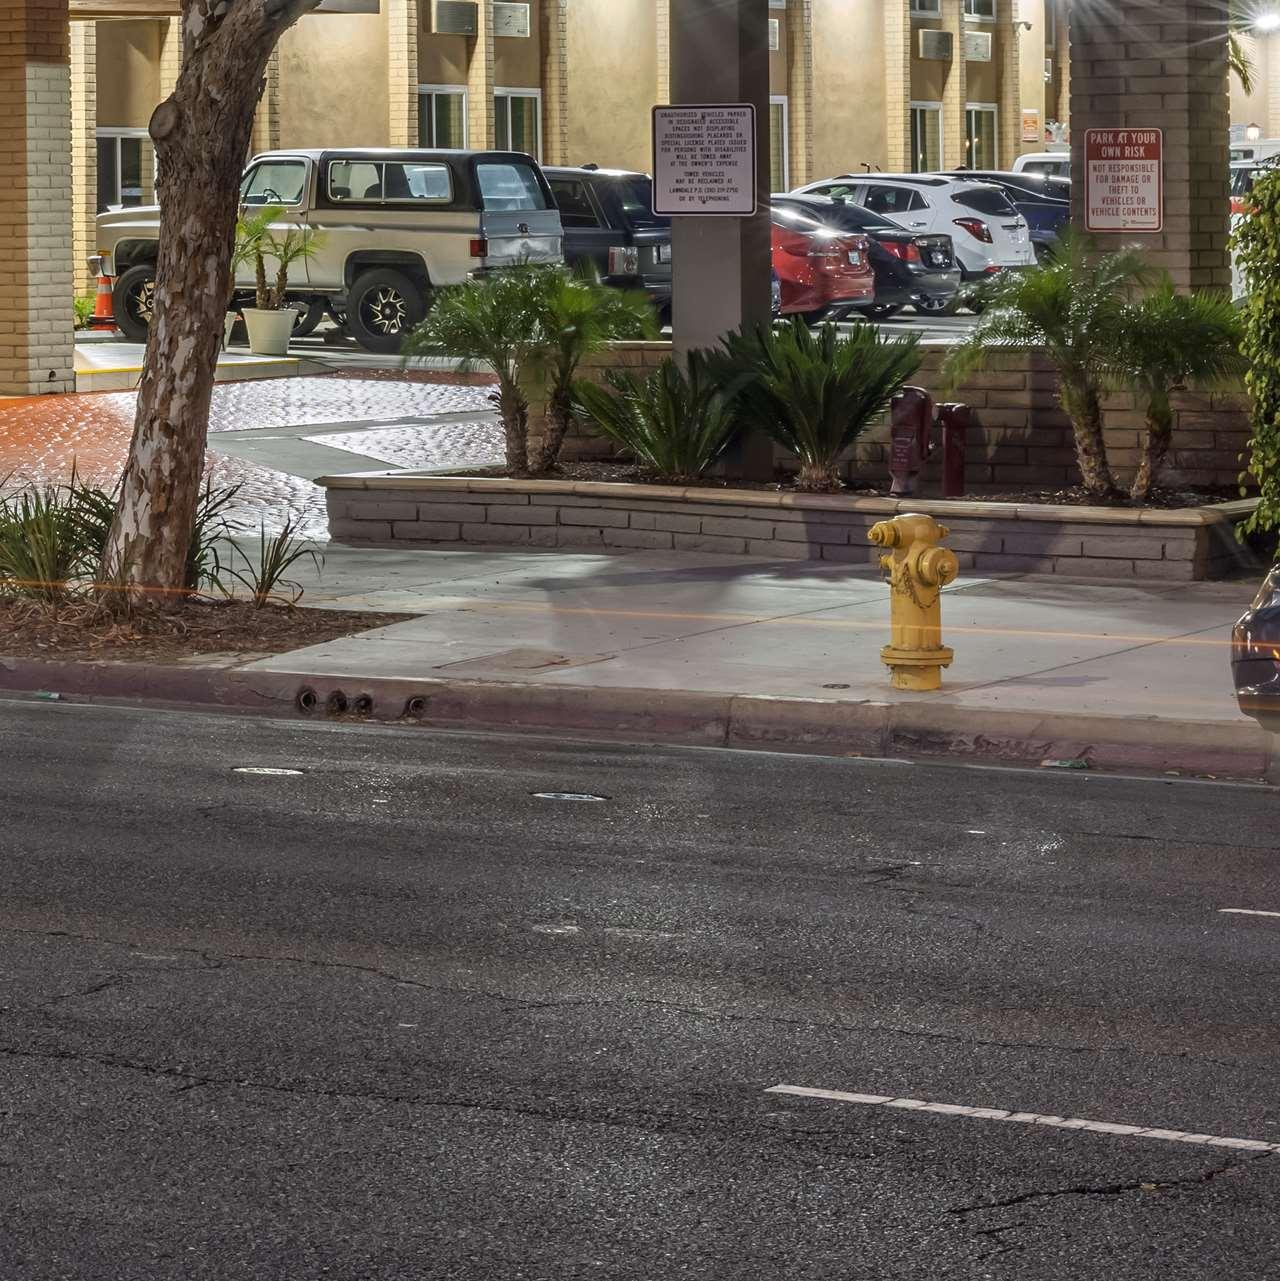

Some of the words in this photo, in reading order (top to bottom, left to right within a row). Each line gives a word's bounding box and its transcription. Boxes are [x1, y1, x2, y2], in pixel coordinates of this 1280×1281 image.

[1090, 132, 1114, 144] PARK
[1119, 132, 1128, 144] AT
[1130, 132, 1156, 144] YOUR
[1101, 146, 1121, 158] OWN
[1124, 146, 1145, 158] RISK
[1092, 164, 1107, 173] NOT
[1108, 164, 1155, 173] RESPONSIBLE
[1095, 175, 1109, 184] FOR
[1111, 175, 1139, 184] DAMAGE
[1141, 175, 1151, 184] OR
[1108, 186, 1128, 195] THEFT
[1131, 186, 1139, 195] TO
[1101, 196, 1134, 205] VEHICLES
[1136, 196, 1146, 205] OR
[1091, 207, 1120, 216] VEHICLE
[1122, 207, 1157, 216] CONTENTS
